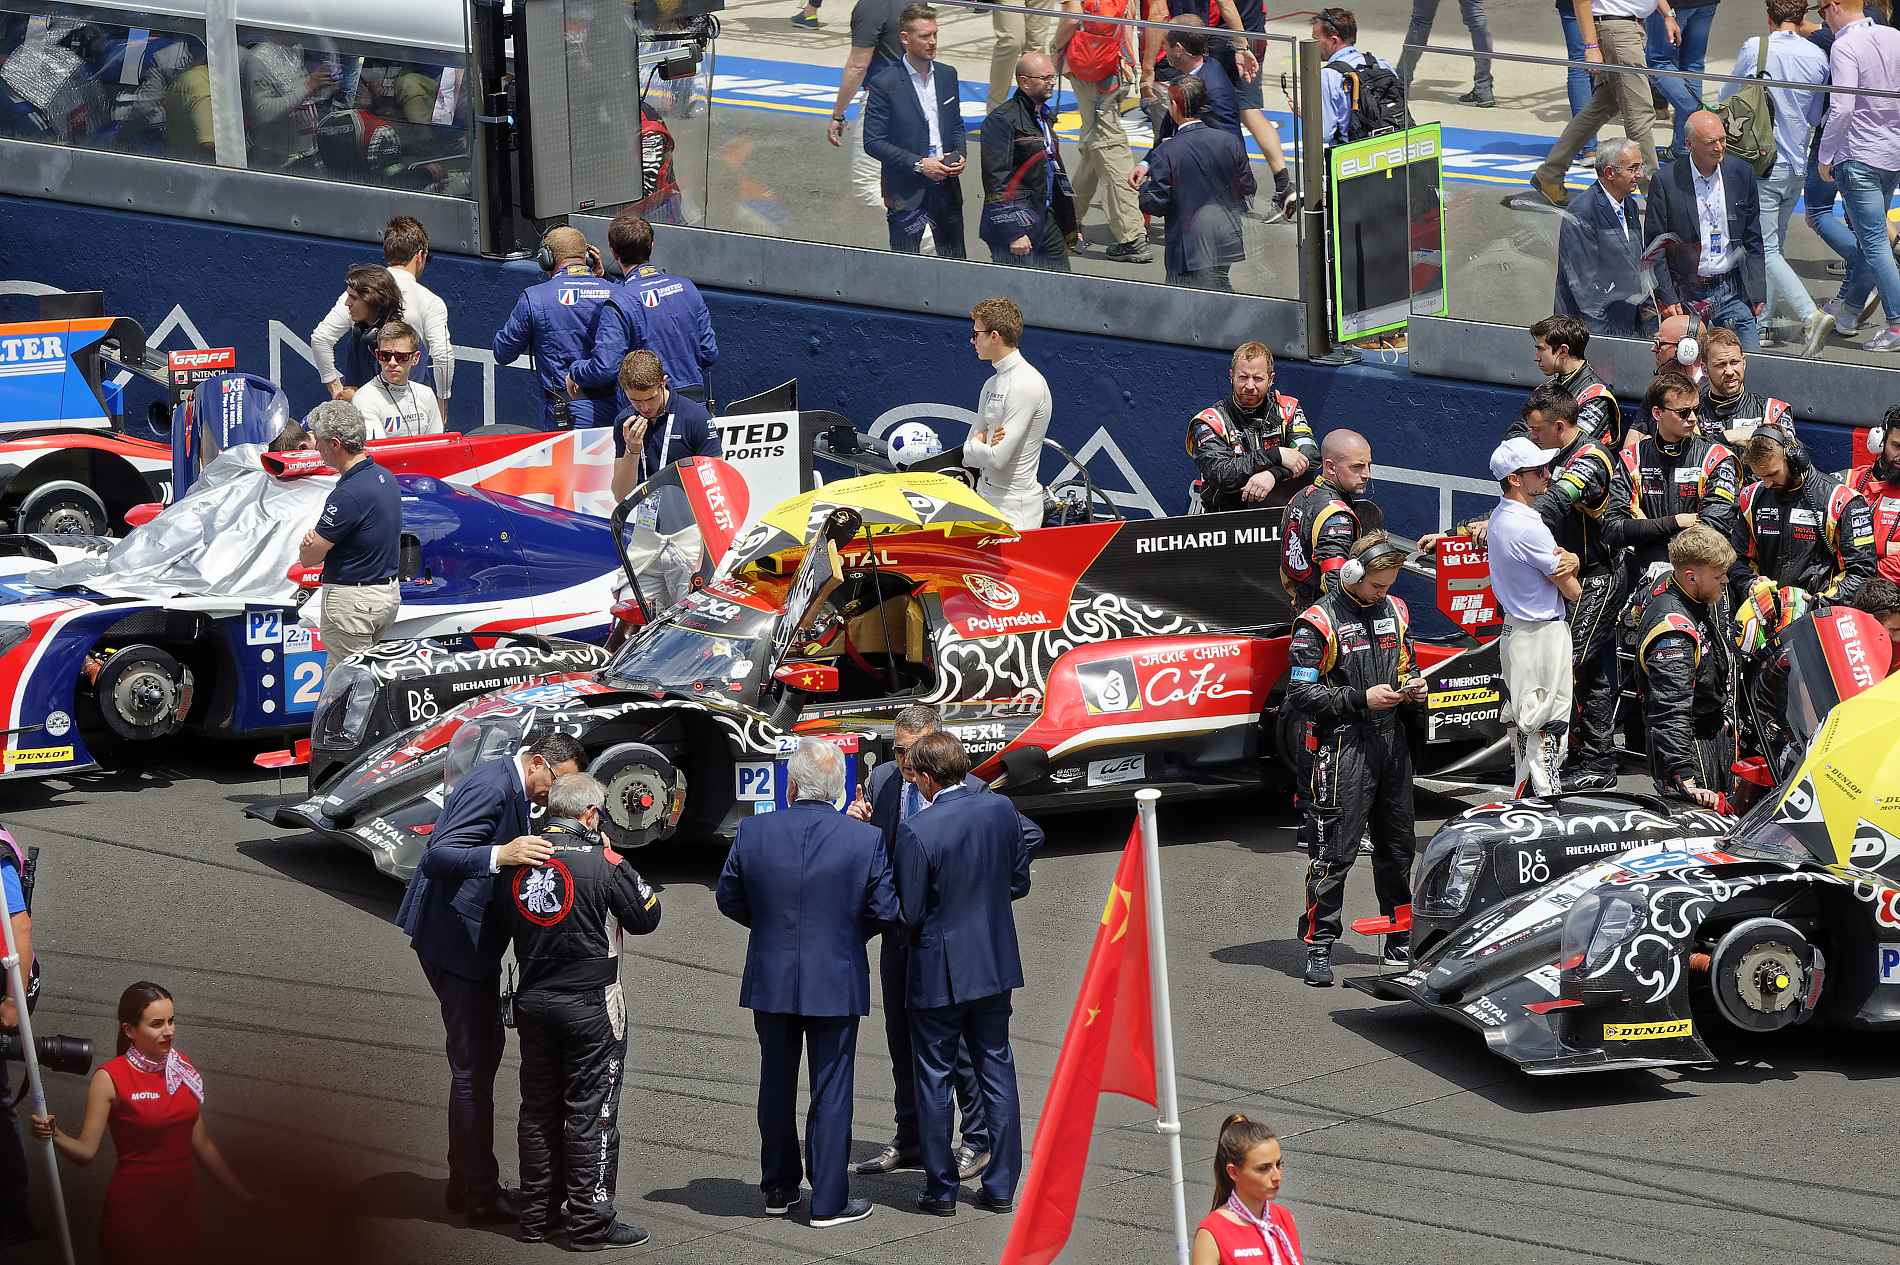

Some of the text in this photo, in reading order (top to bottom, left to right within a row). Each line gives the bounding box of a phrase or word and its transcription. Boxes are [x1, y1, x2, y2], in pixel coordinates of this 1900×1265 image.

[1340, 139, 1435, 176] eurasia
[0, 336, 65, 361] TER
[172, 351, 231, 365] GRAFF
[720, 422, 789, 445] ITED
[725, 446, 785, 461] PORTS
[697, 462, 735, 530] 道达尔
[326, 504, 338, 516] 22
[1136, 526, 1281, 554] RICHARD MILL
[250, 613, 279, 639] P2
[1139, 645, 1241, 666] JACKIE CHAN'S
[1836, 614, 1874, 687] 道达尔
[452, 678, 502, 692] RICHARD
[1145, 663, 1253, 706] Café
[407, 688, 438, 722] B&O
[1441, 690, 1496, 703] DUNLOP
[1444, 709, 1498, 725] sagcom
[832, 738, 856, 747] TAL
[963, 740, 1006, 754] Racing
[17, 751, 69, 760] DUNLOP
[1100, 757, 1143, 775] WEC
[739, 767, 771, 794] P2
[1825, 773, 1857, 801] MOTORSPORT
[1831, 768, 1862, 795] DUNLOP
[370, 817, 406, 846] TOTAL
[1565, 842, 1617, 856] RICHARD
[1518, 849, 1550, 884] B&O
[519, 868, 562, 913] 龍
[1477, 995, 1508, 1022] TOTAL
[1619, 1023, 1689, 1036] DUNLOP
[131, 1092, 161, 1100] MOTUL
[1233, 1247, 1264, 1257] MOTUL
